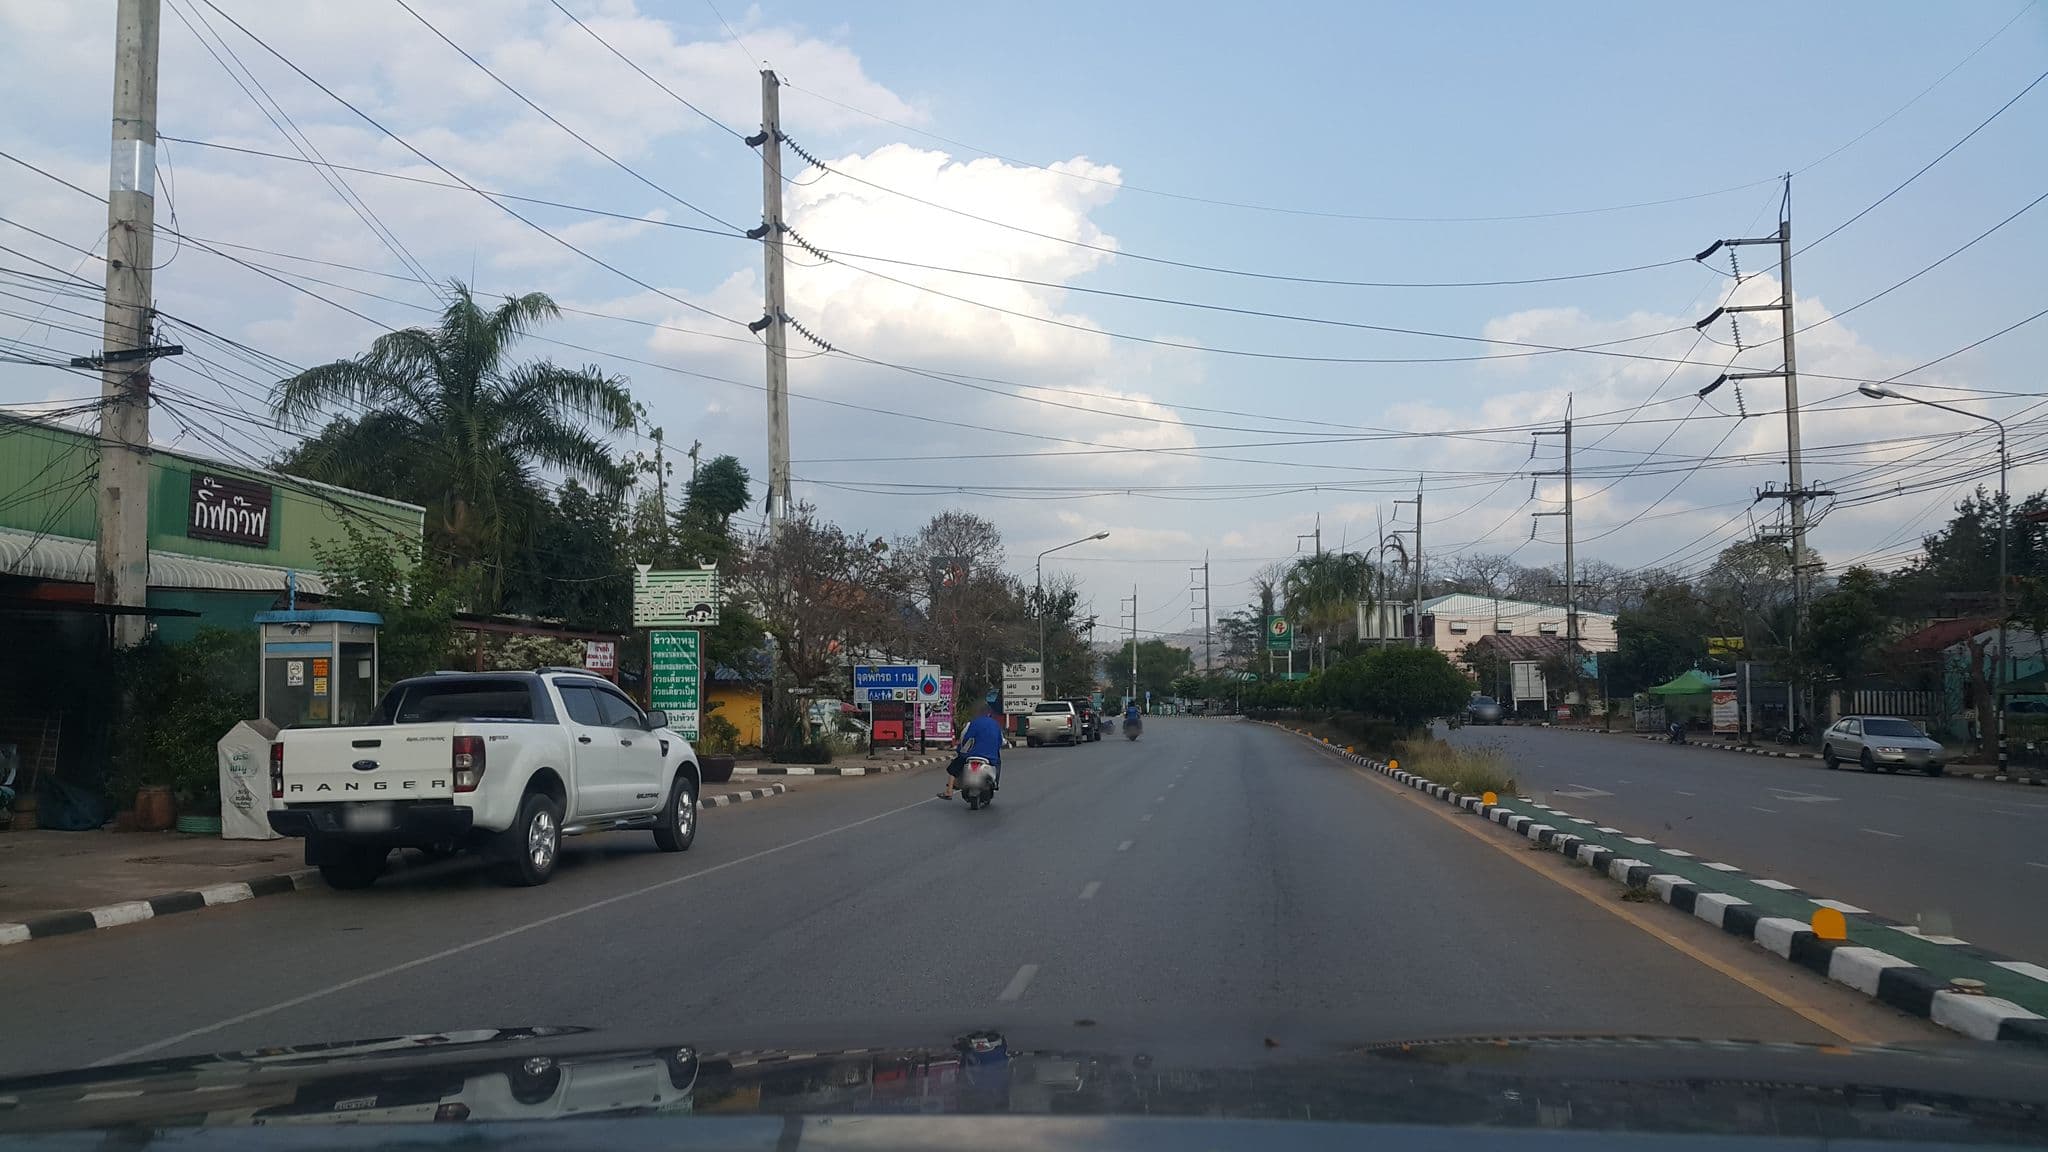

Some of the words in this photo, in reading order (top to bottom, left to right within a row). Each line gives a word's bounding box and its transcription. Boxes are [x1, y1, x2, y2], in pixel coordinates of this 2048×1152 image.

[857, 672, 891, 685] จุดพกรถ
[894, 673, 898, 682] 1
[902, 673, 916, 682] กม.
[290, 779, 446, 792] RANGER
